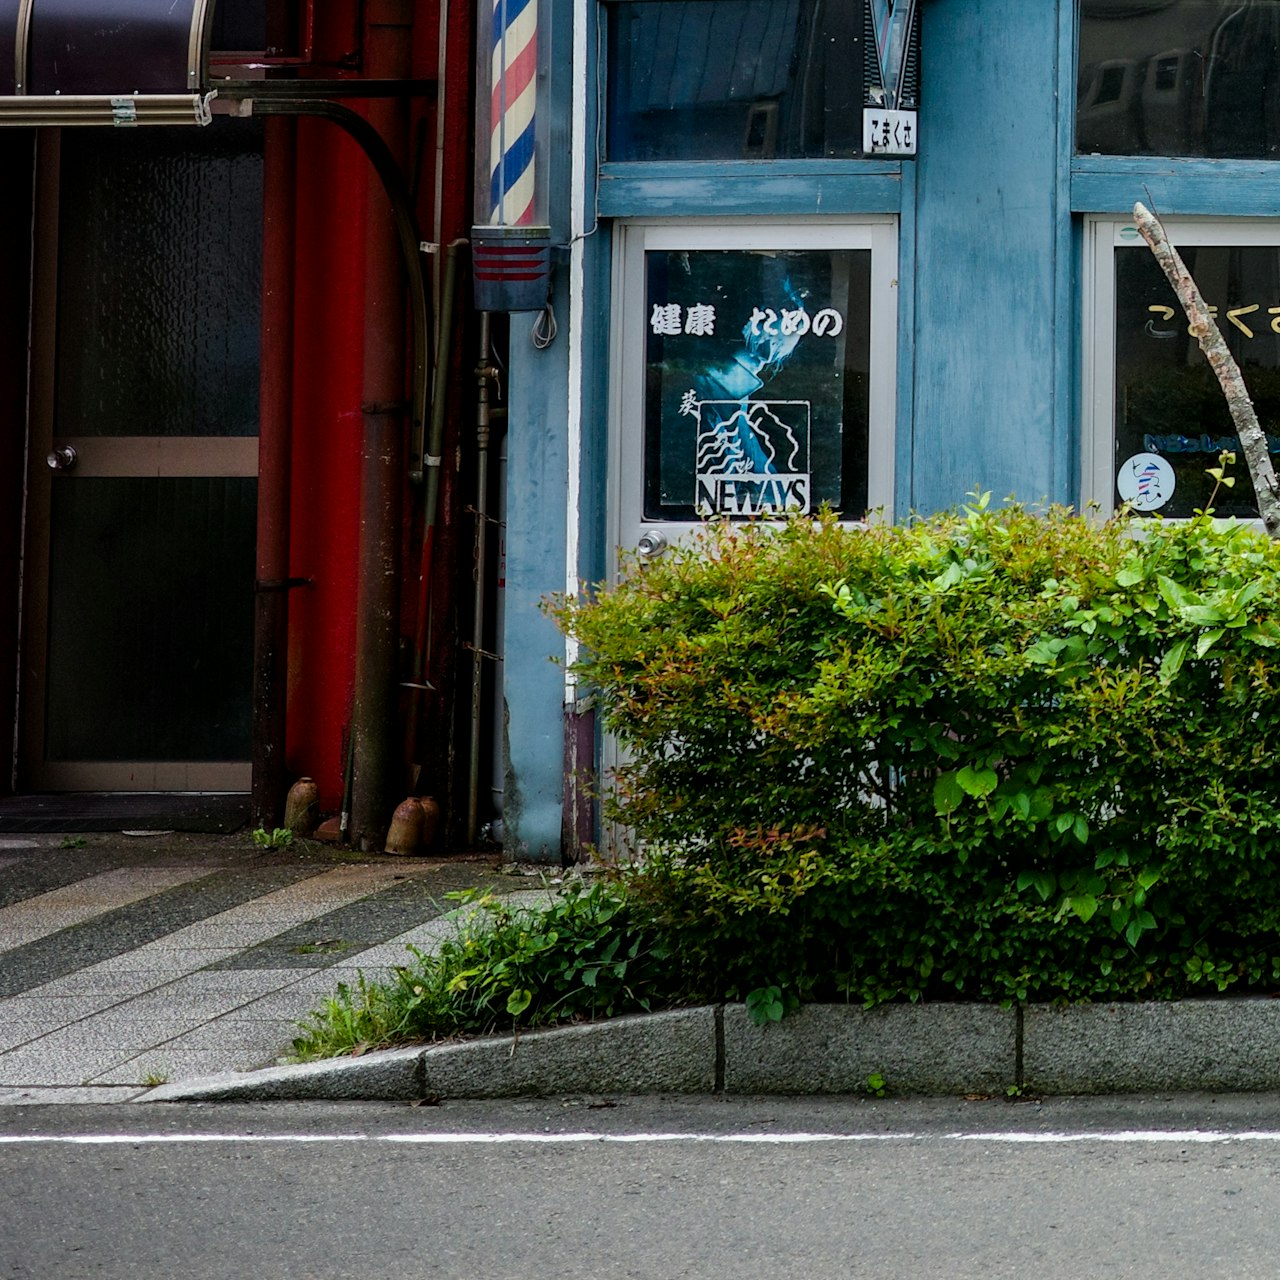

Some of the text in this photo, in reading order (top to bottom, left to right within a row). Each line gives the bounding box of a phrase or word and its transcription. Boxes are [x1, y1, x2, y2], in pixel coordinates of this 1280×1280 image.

[871, 118, 912, 150] こまくさ
[651, 303, 716, 336] 健康
[698, 477, 807, 516] NEWAYS
